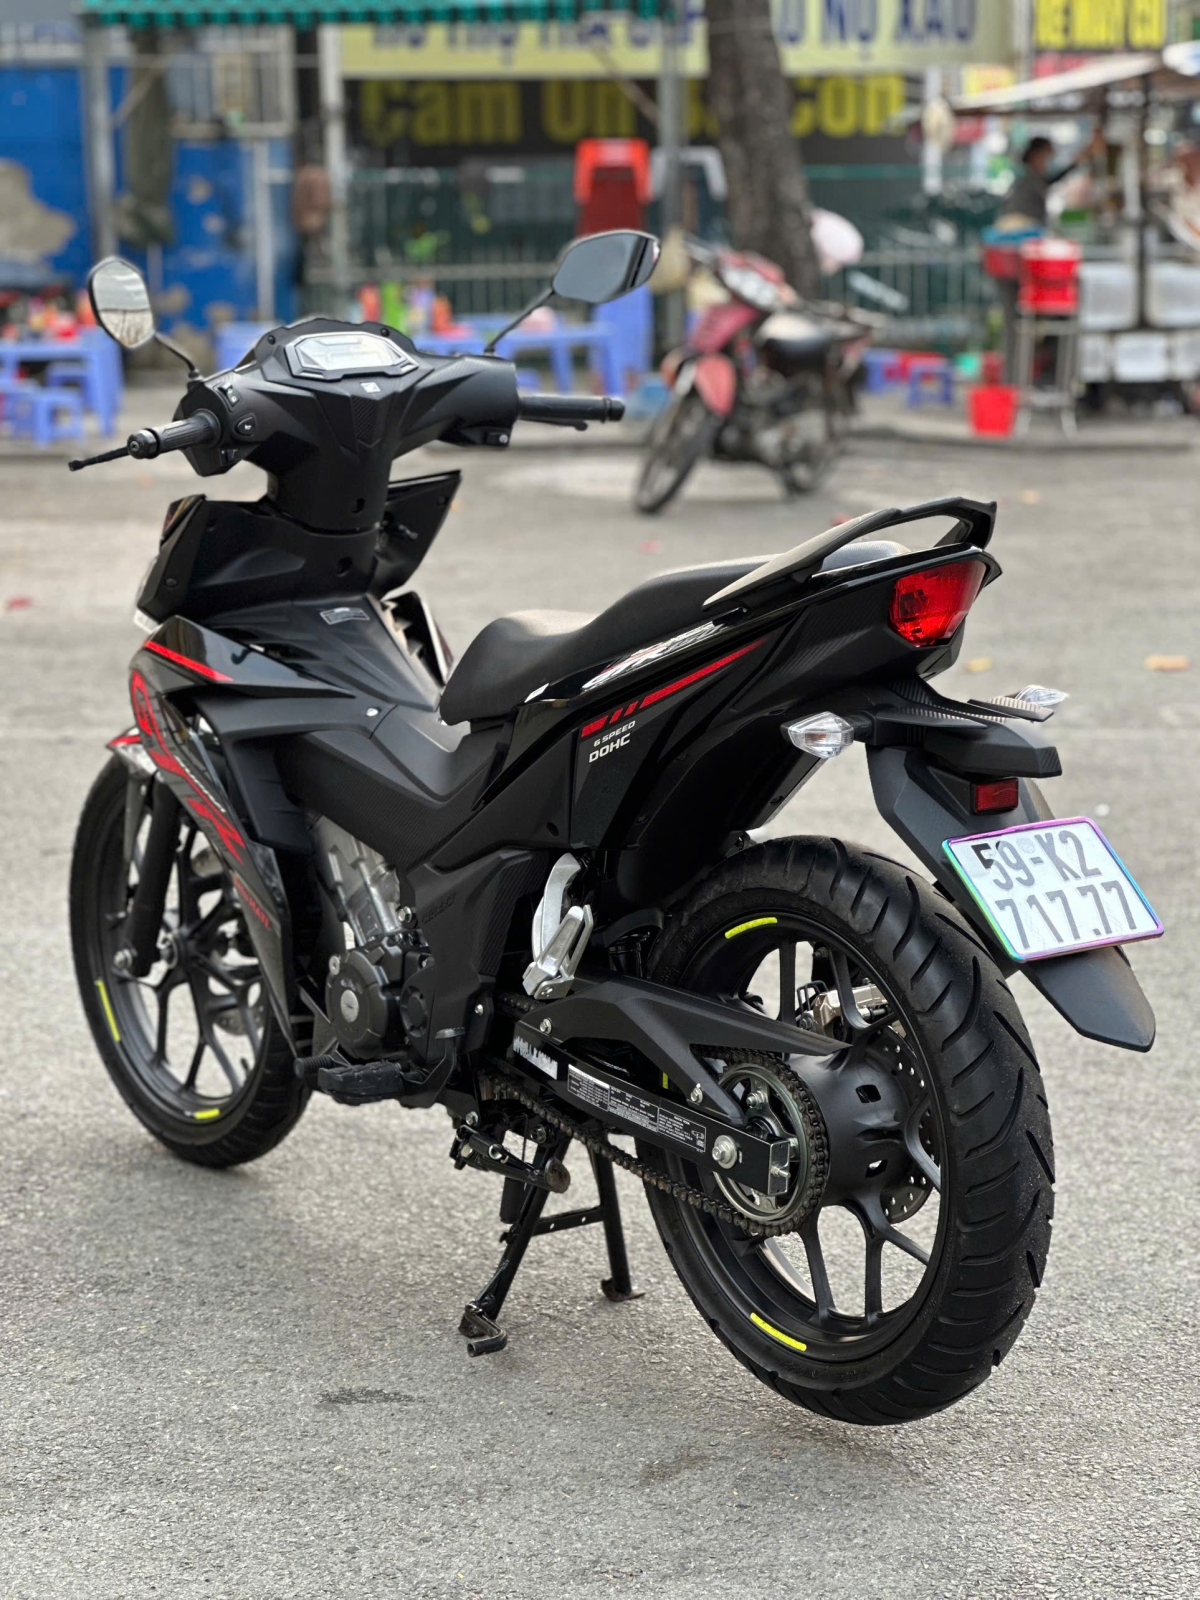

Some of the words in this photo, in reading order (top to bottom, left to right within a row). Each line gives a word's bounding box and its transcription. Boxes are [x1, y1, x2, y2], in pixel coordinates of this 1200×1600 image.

[588, 732, 631, 763] DOHC
[593, 738, 601, 747] 6
[602, 720, 636, 743] SPEED
[971, 830, 1102, 891] 59-K2
[995, 880, 1137, 949] 717.77
